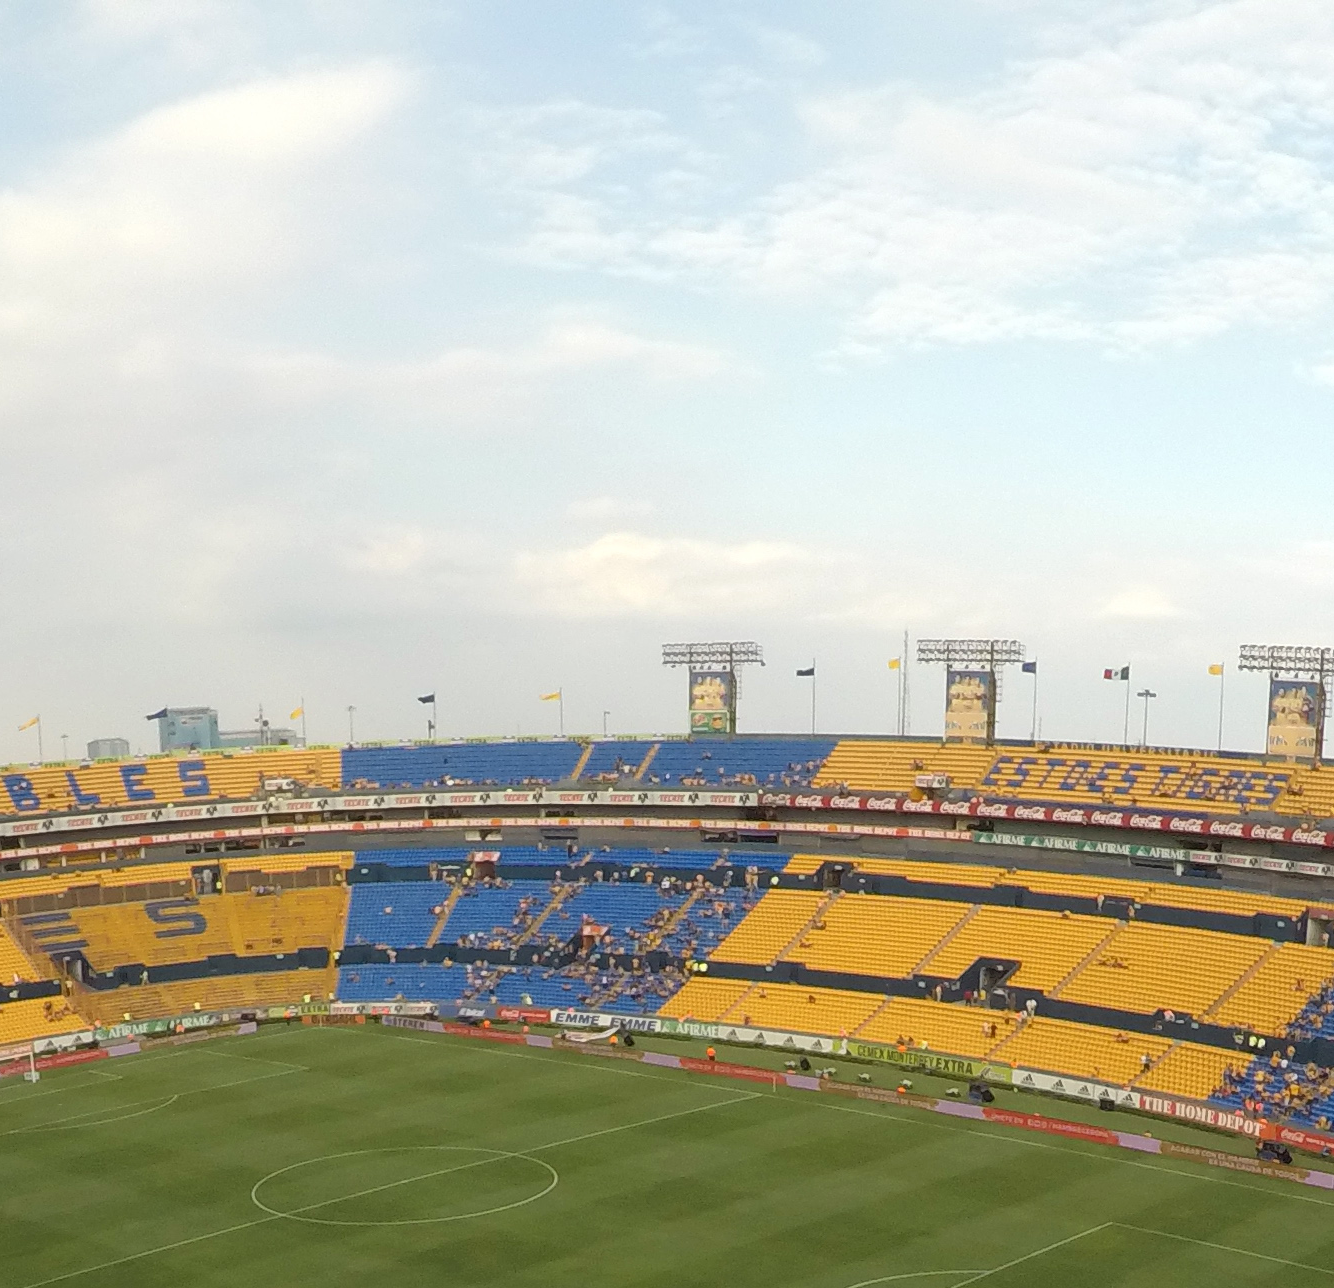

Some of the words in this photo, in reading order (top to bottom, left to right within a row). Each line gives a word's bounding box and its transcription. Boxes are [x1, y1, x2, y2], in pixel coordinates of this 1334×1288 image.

[992, 834, 1025, 846] AFIRME
[1044, 838, 1078, 850] AFIRME
[1096, 843, 1130, 855] AFIRME
[1149, 847, 1186, 860] AFIRME
[555, 1012, 600, 1026] EMME
[857, 1044, 885, 1059] CEMEX
[935, 1056, 973, 1075] EXTRA
[1144, 1096, 1171, 1115] THE
[1175, 1102, 1216, 1125] HOME
[1217, 1111, 1264, 1138] DEPOT
